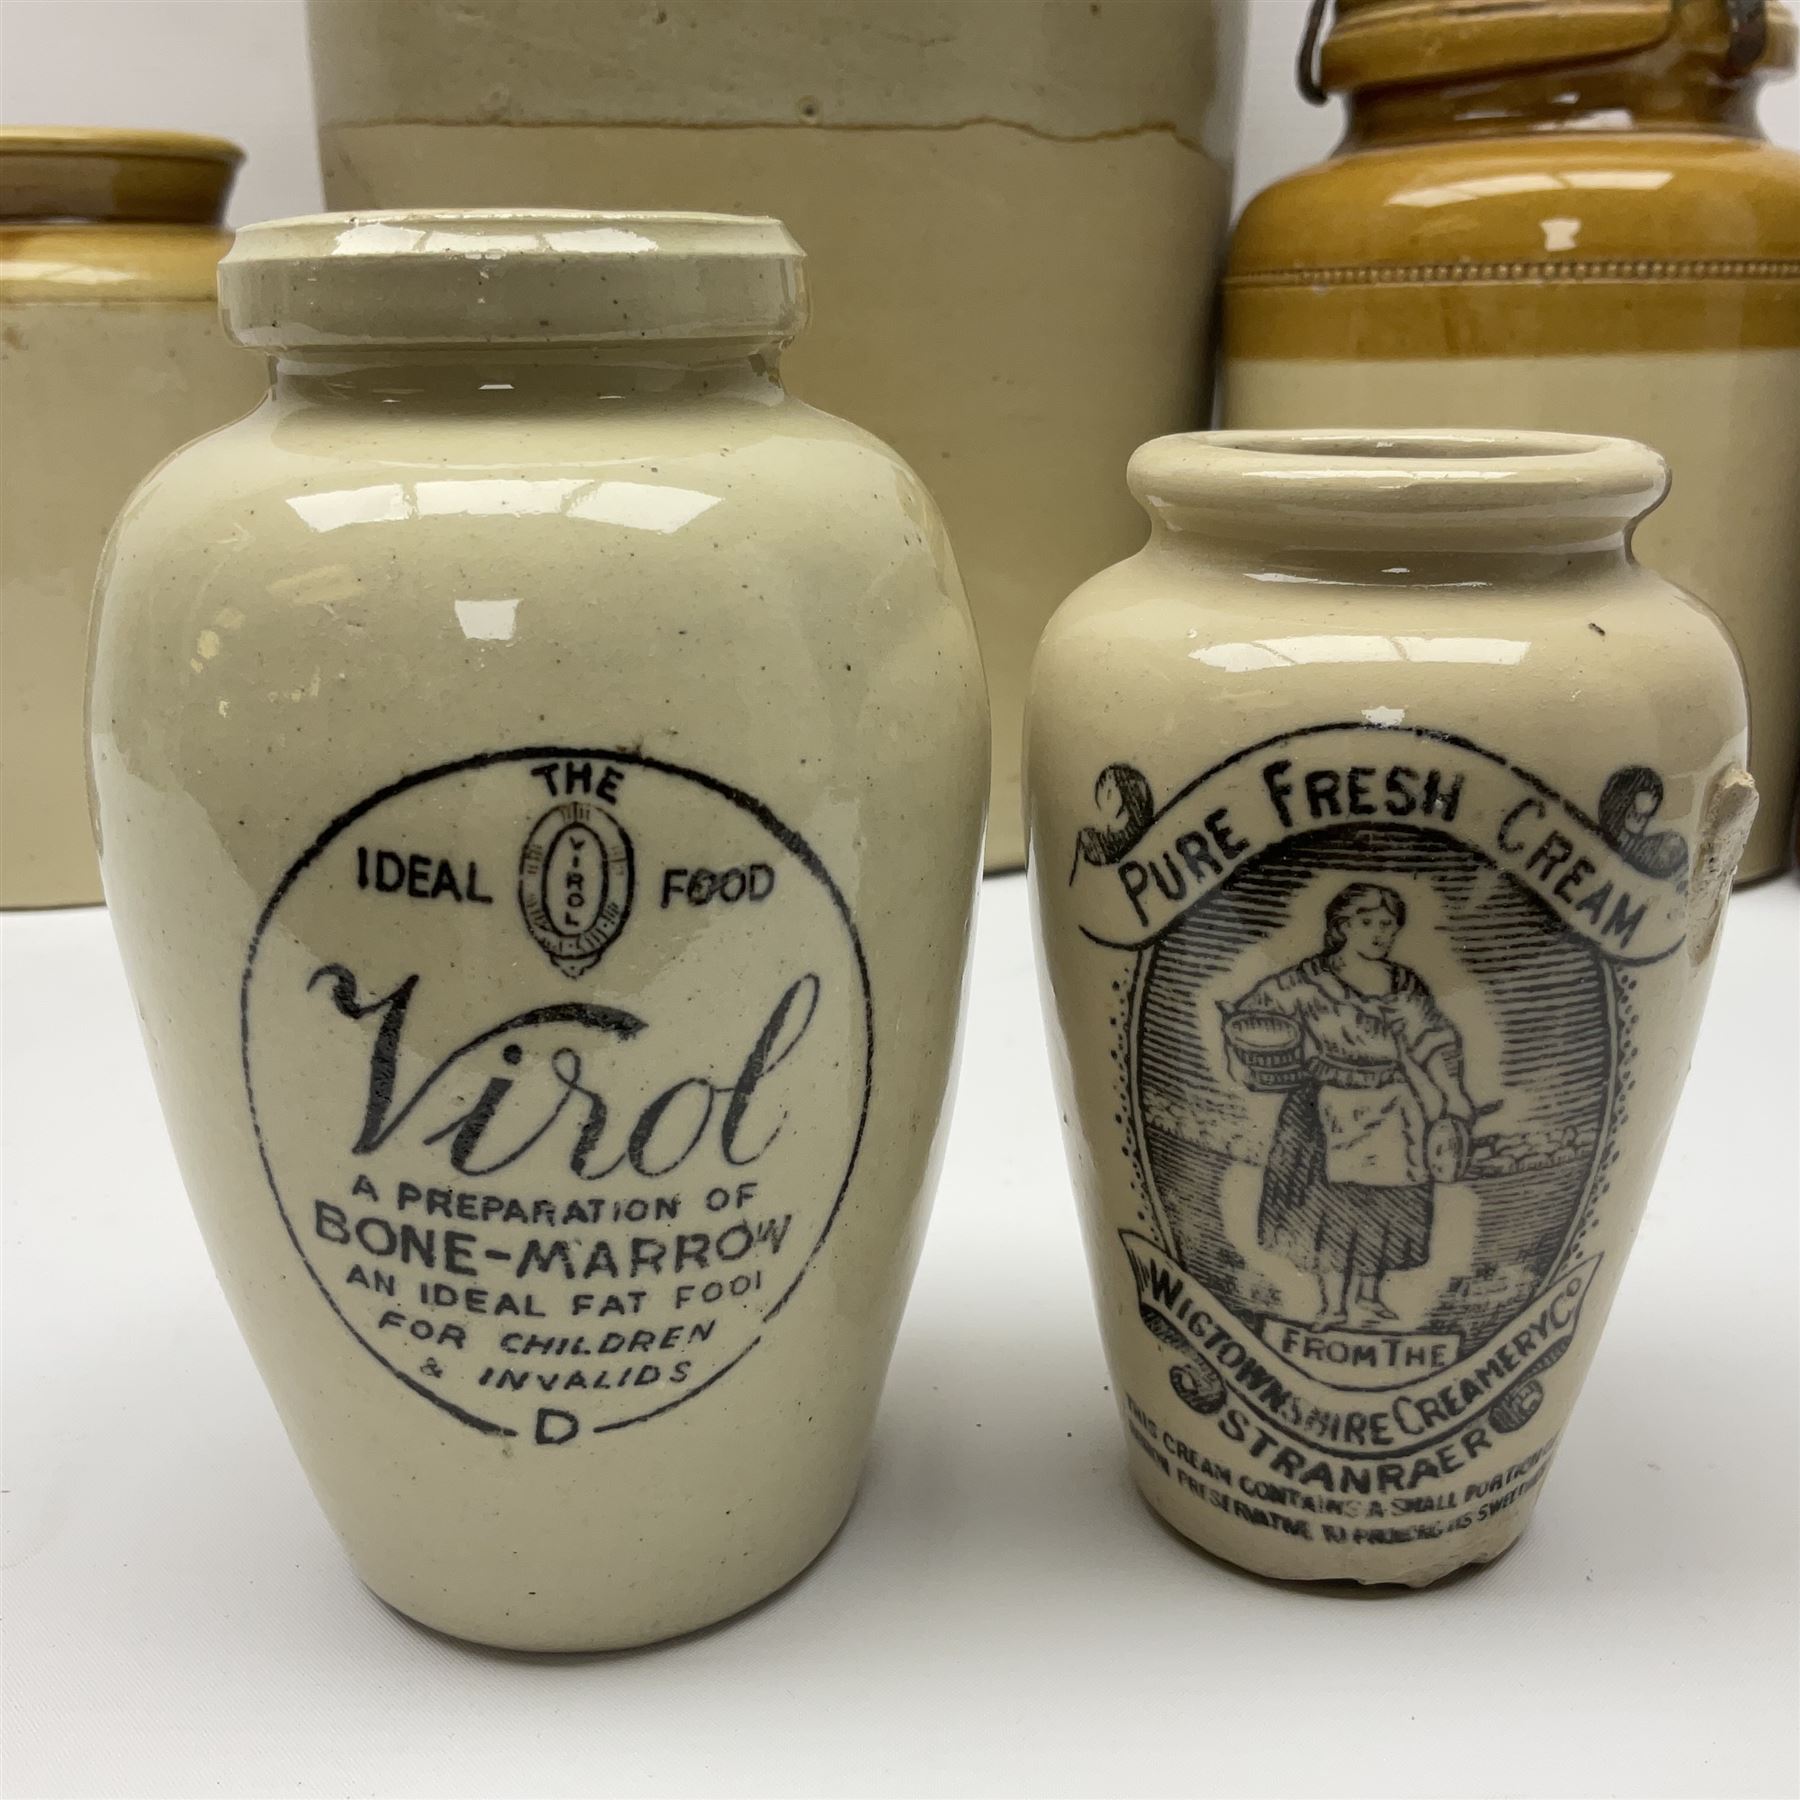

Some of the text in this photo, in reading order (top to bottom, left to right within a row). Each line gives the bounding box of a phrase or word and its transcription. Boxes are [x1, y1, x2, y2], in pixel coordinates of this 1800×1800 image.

[532, 762, 625, 804] THE
[357, 846, 775, 909] IDEAL FOOD
[564, 835, 586, 927] VIROL
[1118, 759, 1648, 948] PURE FRESH CREAM
[306, 963, 820, 1180] Virol
[352, 1174, 758, 1222] A PREPARATION OF
[314, 1200, 793, 1279] BONE-MARROW
[346, 1264, 395, 1297] AN
[421, 1282, 546, 1318] IDEAL
[572, 1291, 646, 1317] FAT
[378, 1311, 716, 1356] FOR CHILDREN
[1282, 1327, 1447, 1368] FROM THE
[420, 1356, 693, 1391] & INVALIDS
[1392, 1311, 1549, 1435] CREAMERY
[535, 1407, 580, 1445] D
[1218, 1409, 1492, 1493] STRANRAER
[1162, 1431, 1231, 1487] CREAM
